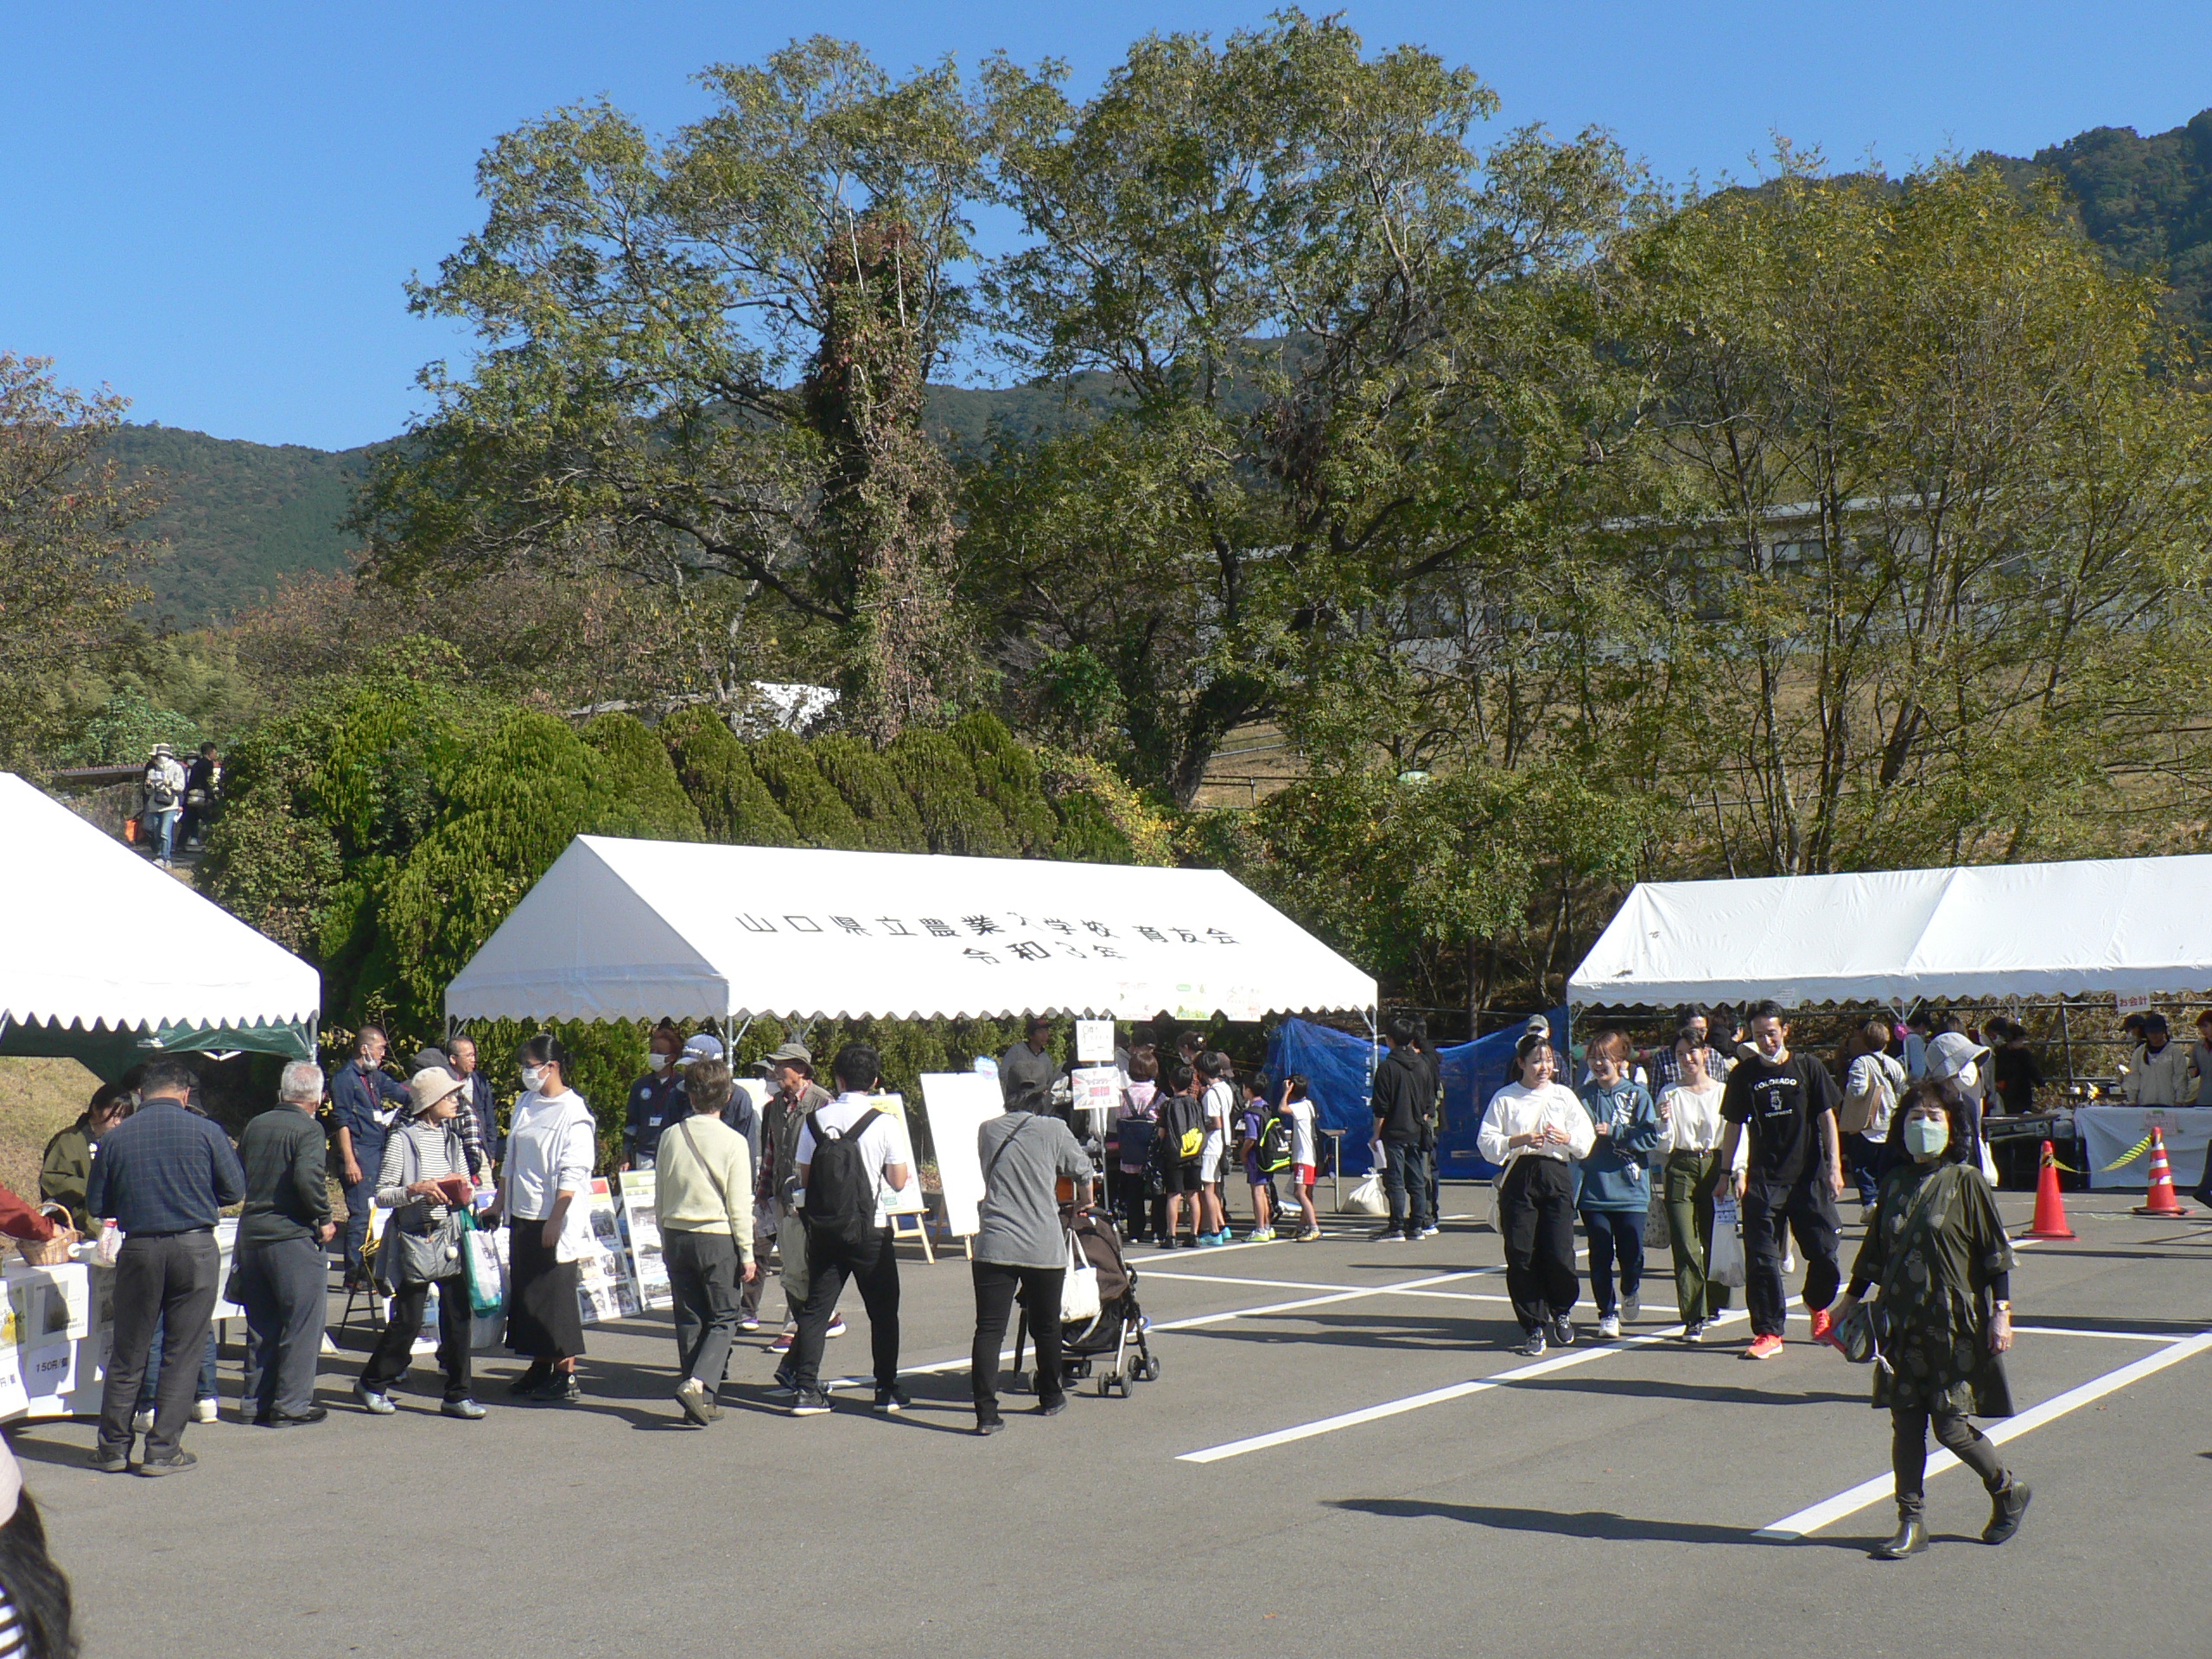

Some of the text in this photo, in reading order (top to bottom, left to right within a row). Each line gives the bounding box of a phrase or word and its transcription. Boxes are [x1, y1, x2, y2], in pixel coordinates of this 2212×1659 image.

[2119, 995, 2147, 1007] お会計
[1754, 1077, 1797, 1090] COLORADO
